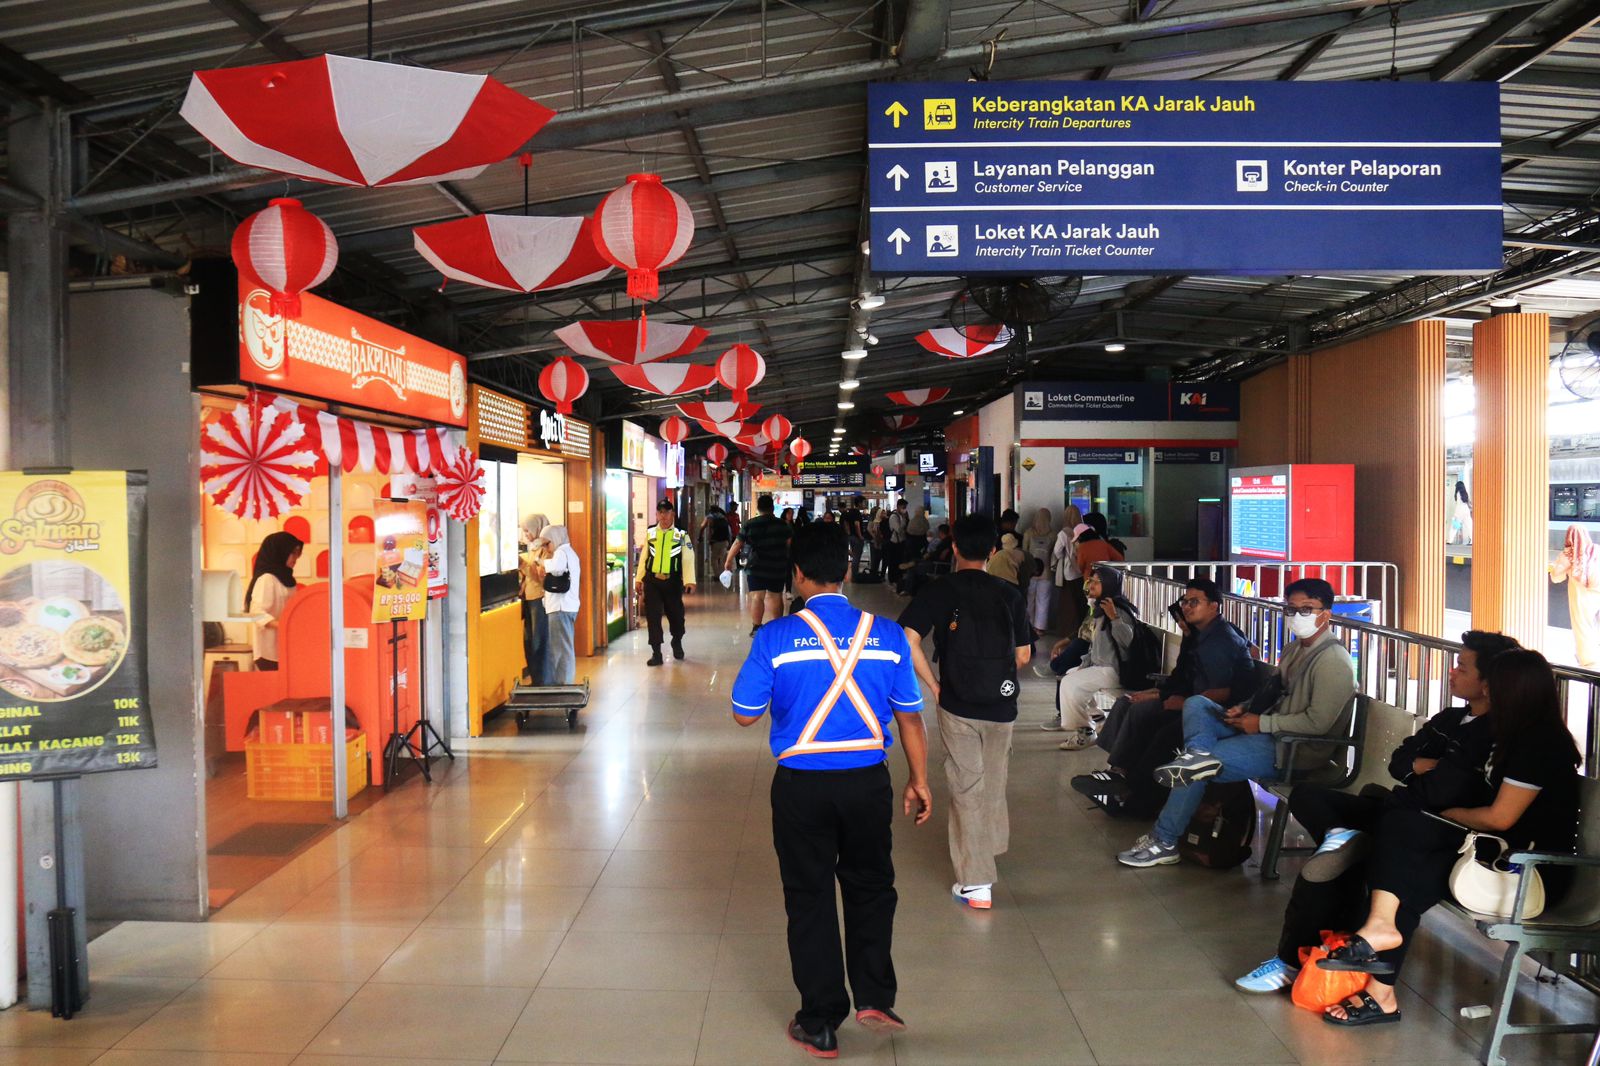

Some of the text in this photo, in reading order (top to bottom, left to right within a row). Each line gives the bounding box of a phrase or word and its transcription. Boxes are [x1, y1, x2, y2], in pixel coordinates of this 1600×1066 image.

[972, 95, 1255, 115] Keberangkatan KA Jarak Jauh
[973, 117, 1131, 131] Intercity Train Departures
[973, 159, 1155, 180] Layanan Pelanggan
[1283, 159, 1442, 180] Konter Pelaporan
[974, 181, 1083, 193] Customer Service
[1284, 180, 1389, 192] Check-in Counter
[974, 222, 1160, 240] Loket KA Jarak Jauh
[975, 244, 1155, 259] Intercity Train Ticket Counter
[351, 343, 407, 389] BAKPIAMU
[1047, 393, 1135, 402] Loket Commuterline
[0, 518, 100, 555] Salman
[847, 636, 880, 647] CRE
[113, 697, 140, 710] 10K
[117, 715, 141, 727] 11K
[38, 735, 105, 751] KACANG
[115, 733, 141, 745] 12K
[116, 751, 141, 763] 13K
